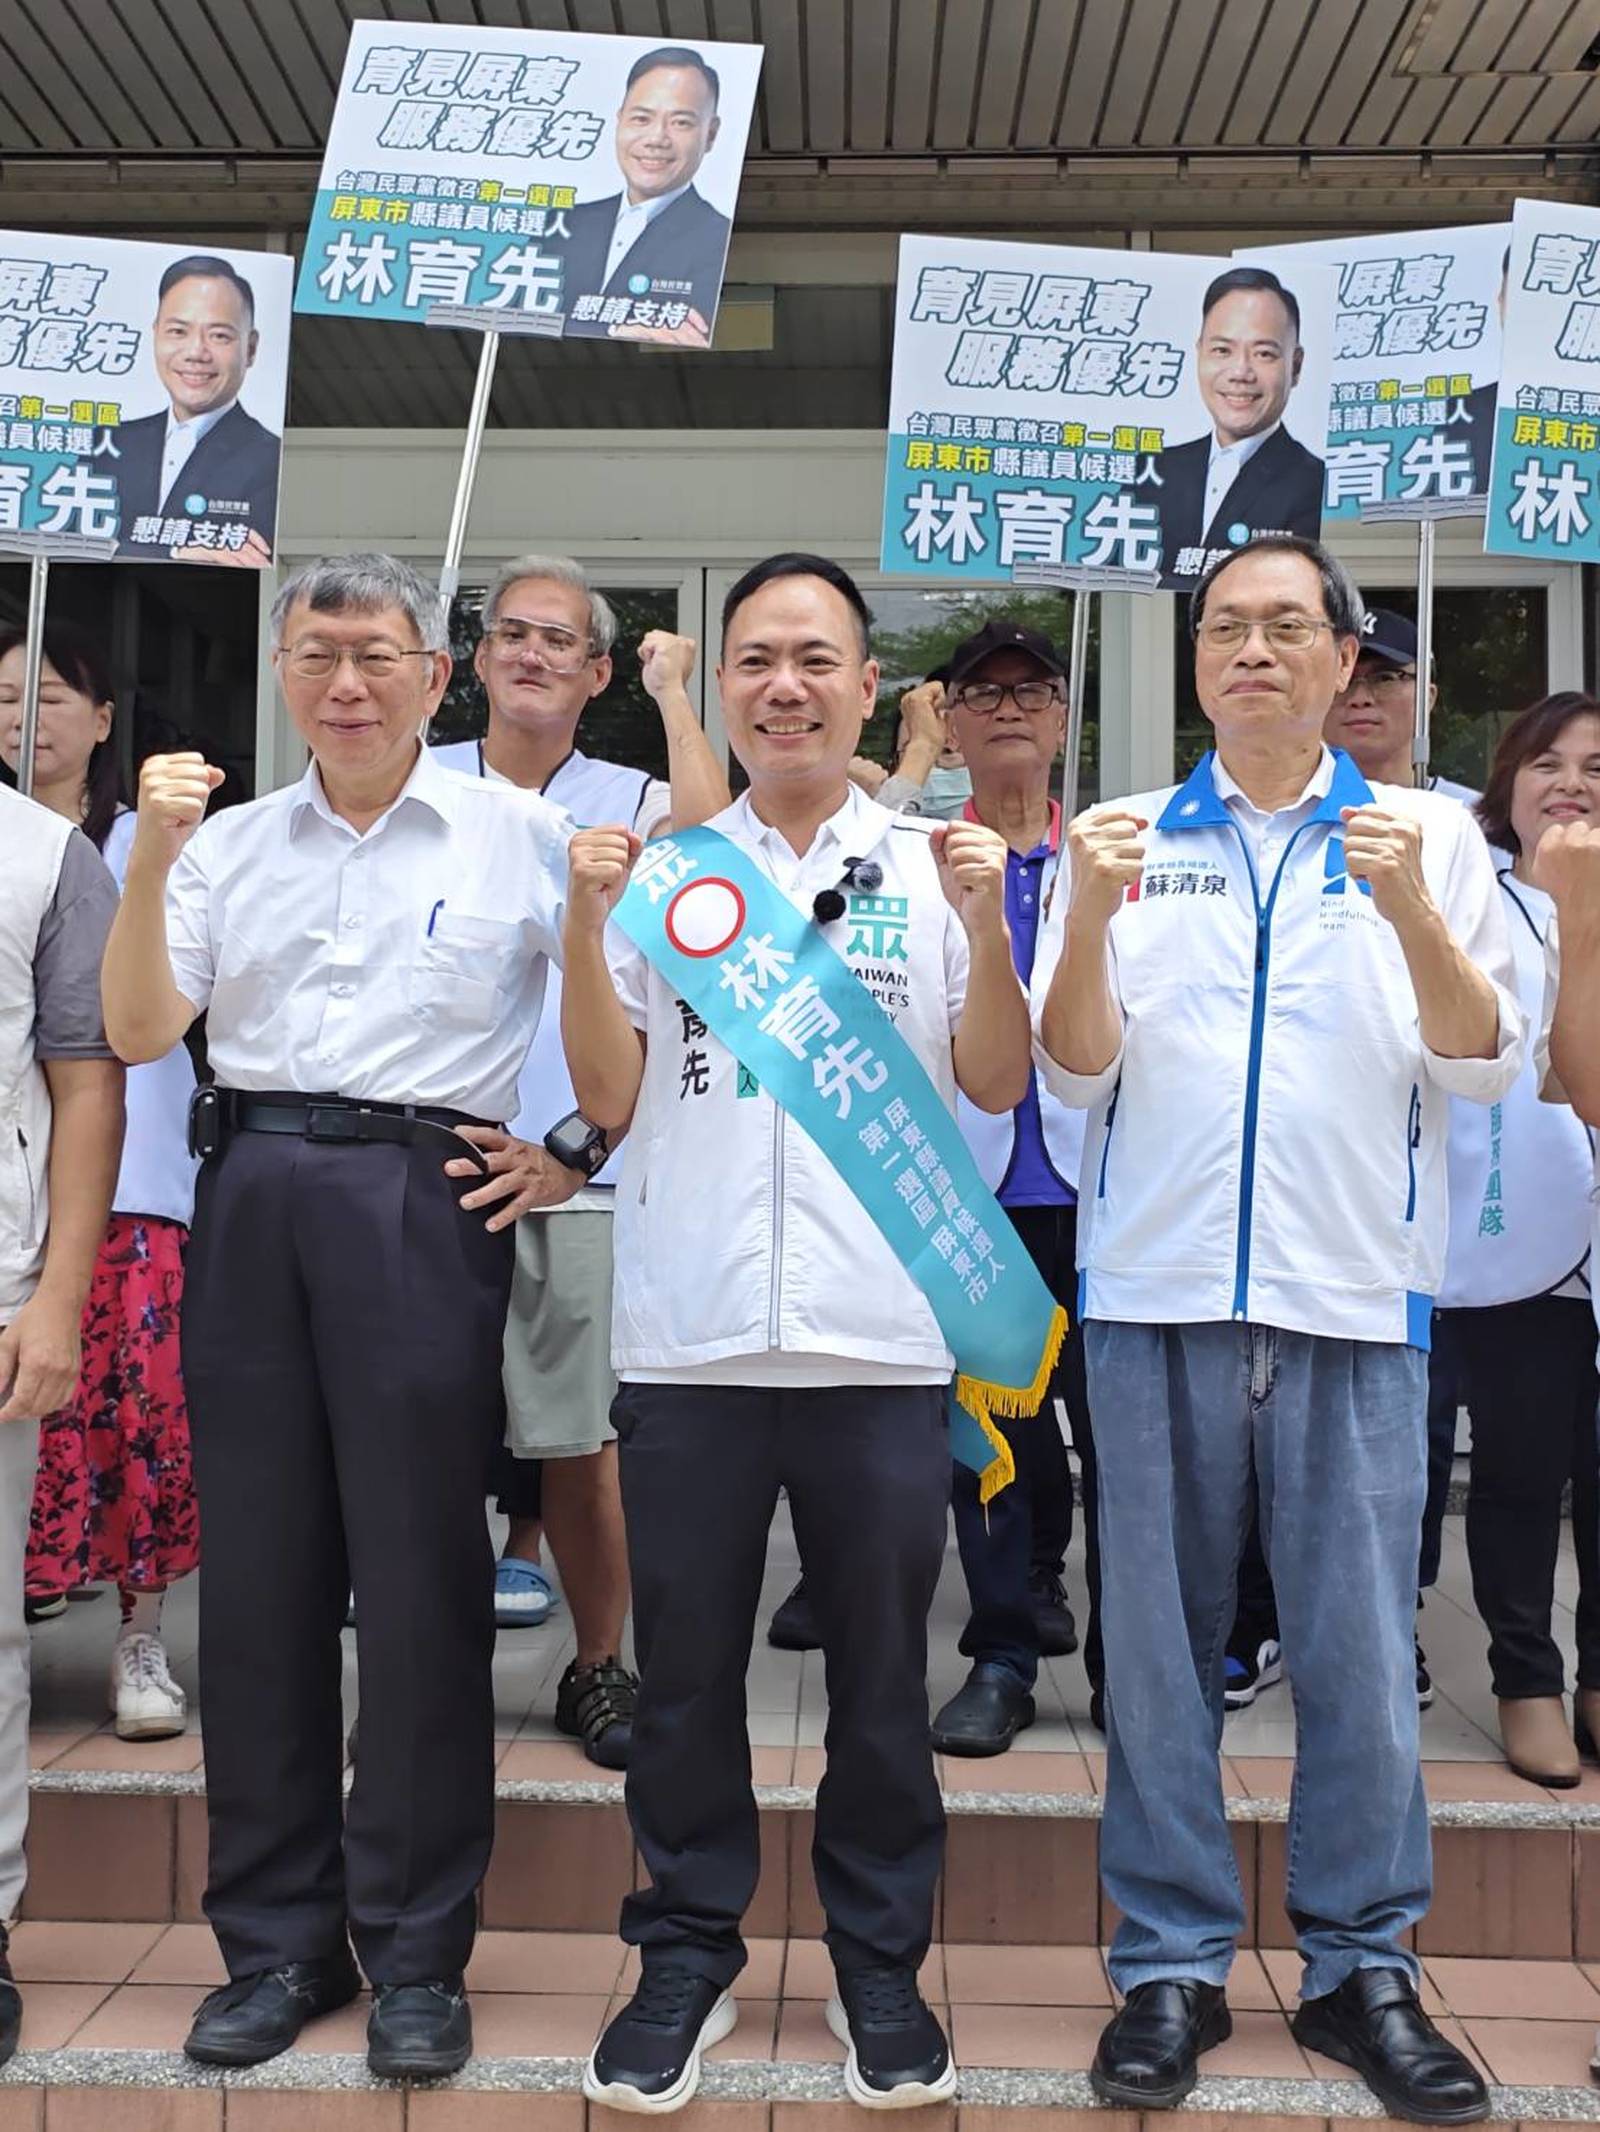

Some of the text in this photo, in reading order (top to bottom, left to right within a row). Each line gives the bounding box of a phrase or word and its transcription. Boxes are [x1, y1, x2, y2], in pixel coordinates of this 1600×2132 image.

[352, 46, 581, 105] 育見屏東
[377, 99, 606, 160] 服務優先
[331, 196, 571, 239] 屏東市縣議員候選人
[318, 232, 562, 313] 林育先
[1329, 254, 1454, 308] 屏東
[571, 294, 689, 329] 懇請支持
[910, 267, 1152, 336] 育見屏東
[945, 329, 1185, 398] 服務優先
[1331, 374, 1472, 402] 徵召第一選區
[0, 422, 121, 458] 員候選人
[906, 441, 1164, 487] 屏東市縣議員候選人
[1325, 435, 1472, 507] 育先
[130, 516, 248, 549] 懇請支持
[904, 483, 1160, 570] 林育先
[1145, 872, 1226, 899] 蘇清泉
[851, 967, 908, 988] AIWAN
[719, 932, 888, 1119] 林育先
